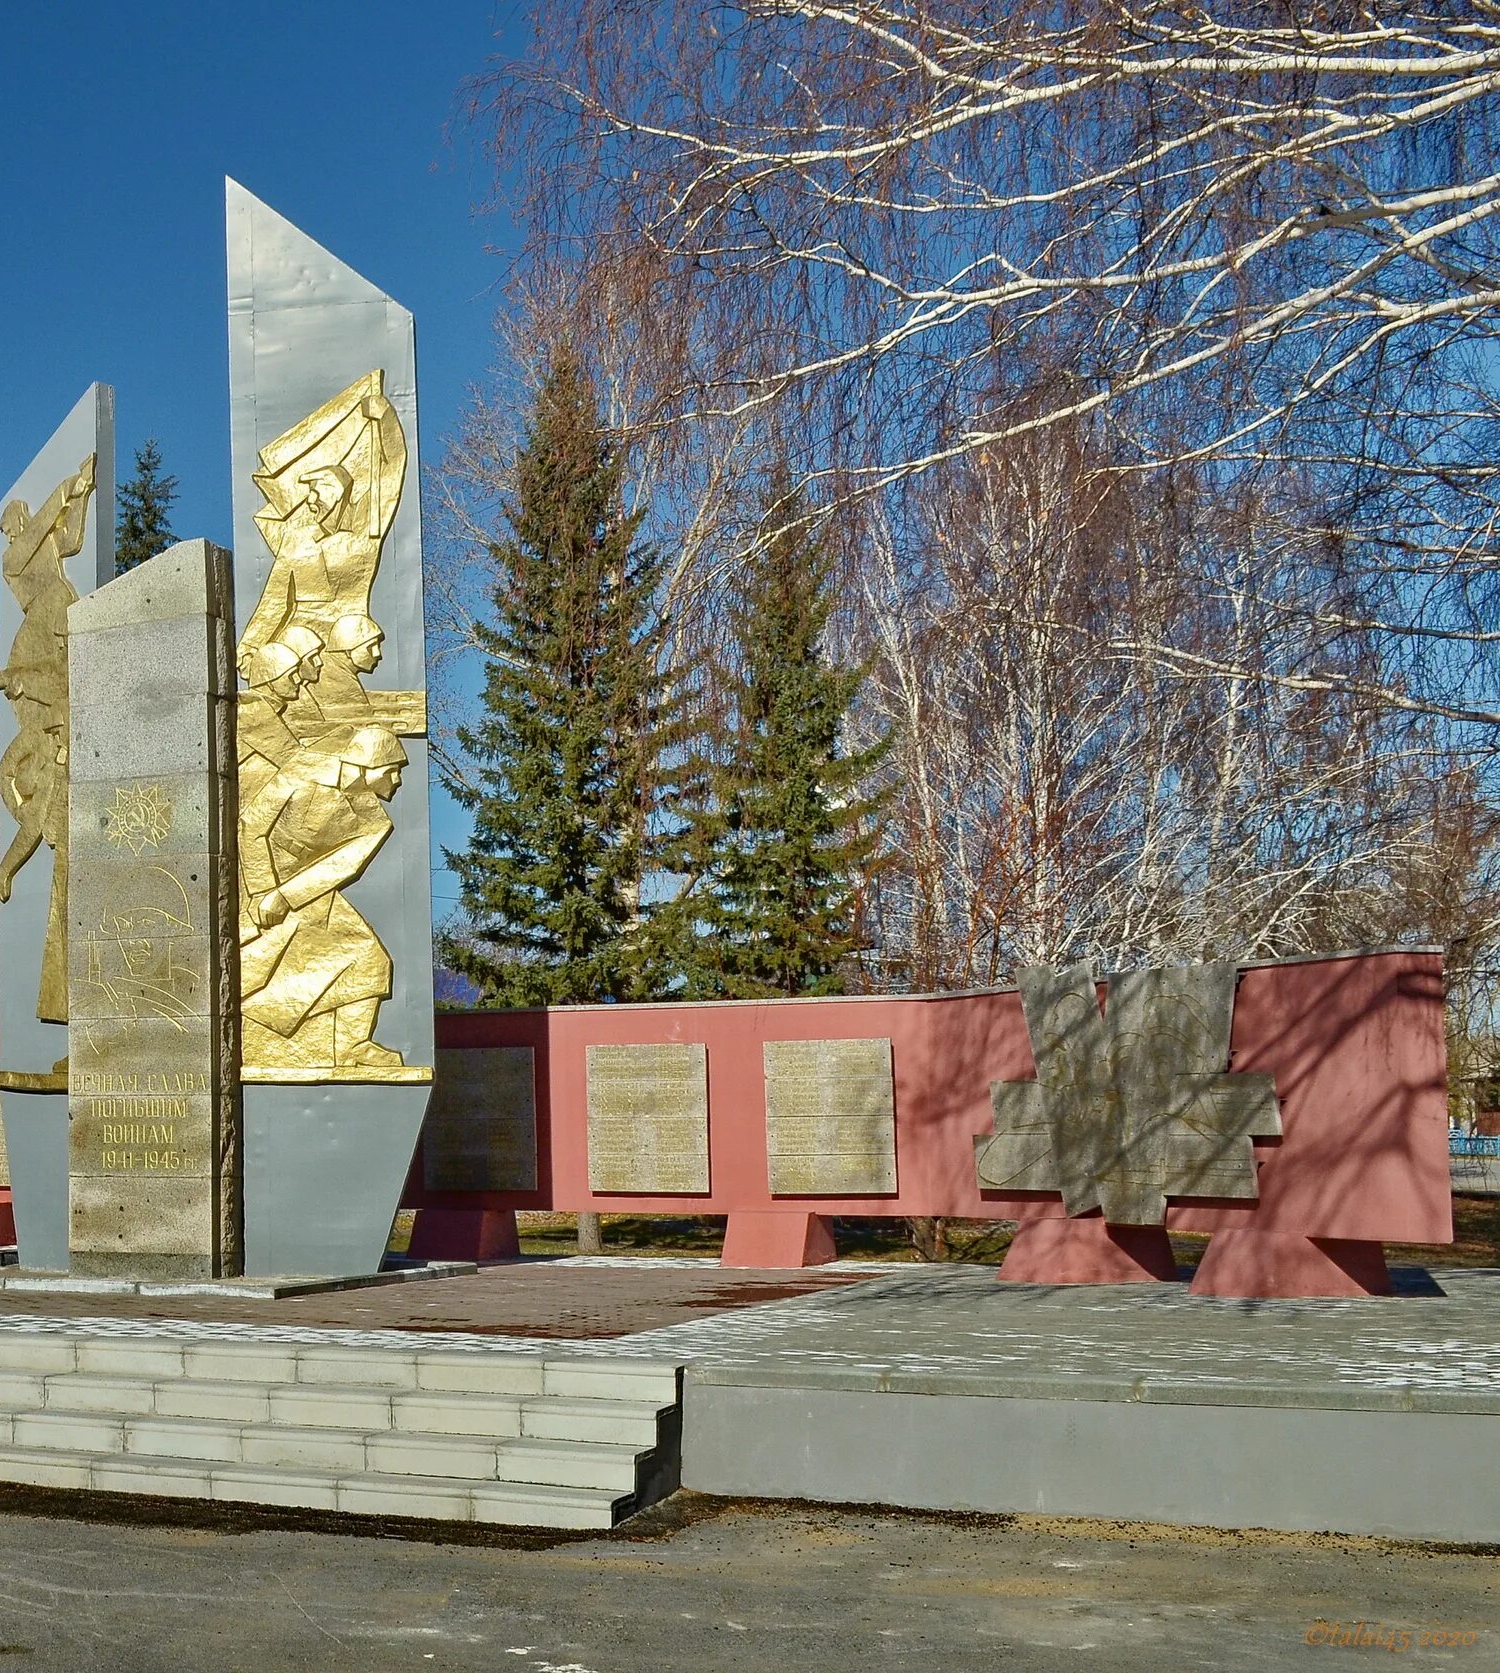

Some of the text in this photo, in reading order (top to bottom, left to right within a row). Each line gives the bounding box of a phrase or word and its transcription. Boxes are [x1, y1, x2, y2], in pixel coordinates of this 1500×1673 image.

[72, 1072, 207, 1092] ВЕЧНАЯ СЛАВА
[91, 1098, 187, 1118] ПОГИБШИМ
[102, 1124, 173, 1144] ВОИНАМ
[102, 1150, 180, 1169] 1941-1945
